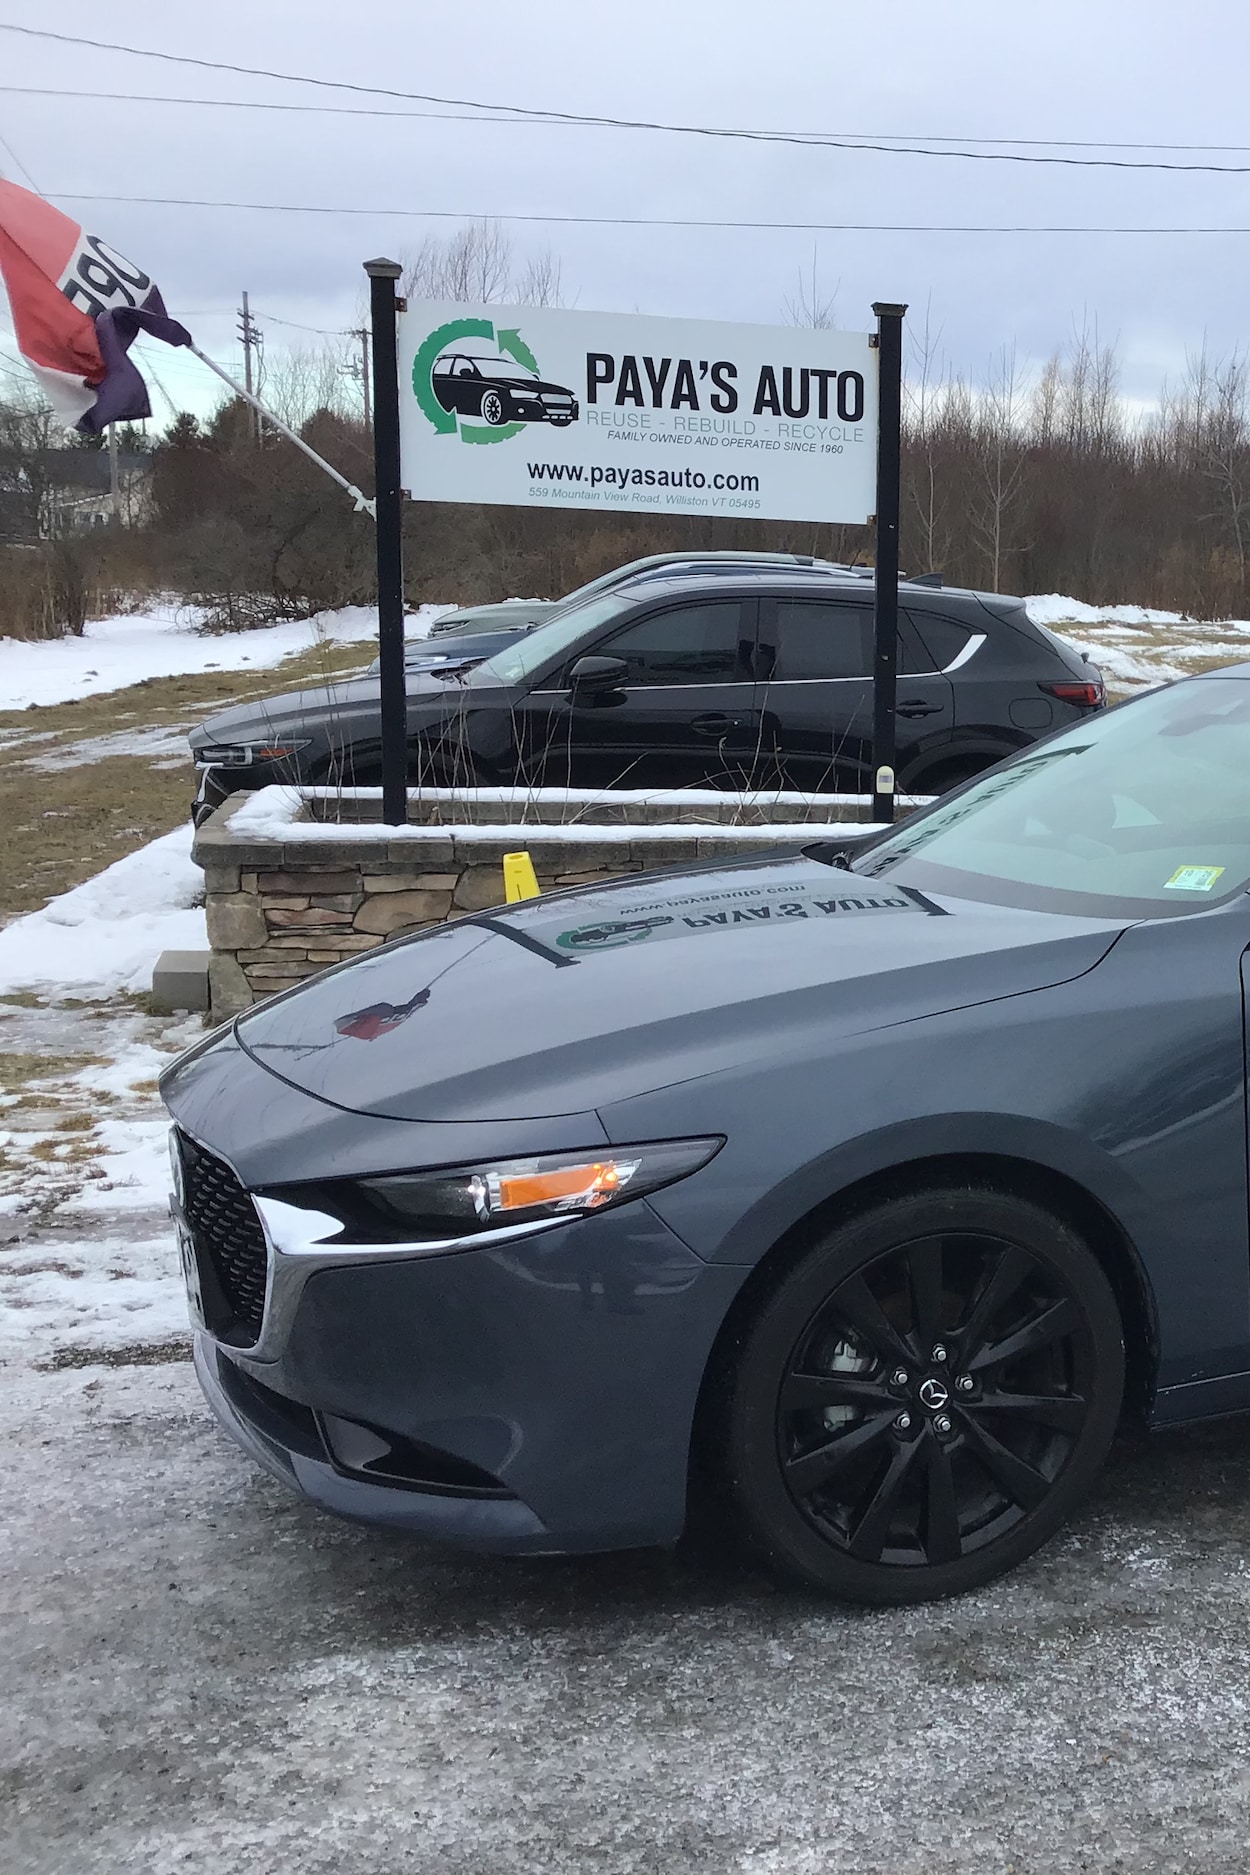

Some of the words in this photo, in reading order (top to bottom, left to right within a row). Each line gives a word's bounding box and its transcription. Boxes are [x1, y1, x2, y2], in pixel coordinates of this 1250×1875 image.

[586, 352, 738, 414] PAYA'S
[752, 365, 864, 422] AUTO
[586, 410, 652, 429] REUSE
[674, 416, 756, 435] REBUILD
[778, 422, 864, 442] RECYCLE
[607, 430, 647, 442] FAMILY
[649, 433, 693, 445] OWNED
[694, 436, 720, 447] AND
[721, 437, 781, 450] OPERATED
[783, 441, 816, 452] SINCE
[820, 444, 844, 454] 1960
[526, 462, 759, 491] www.payasauto.com
[528, 487, 549, 497] 559
[551, 488, 600, 500] Mountain
[604, 491, 629, 501] View
[631, 492, 662, 504] Road,
[665, 494, 708, 506] Williston
[711, 497, 727, 507] VT
[728, 498, 761, 509] 05495
